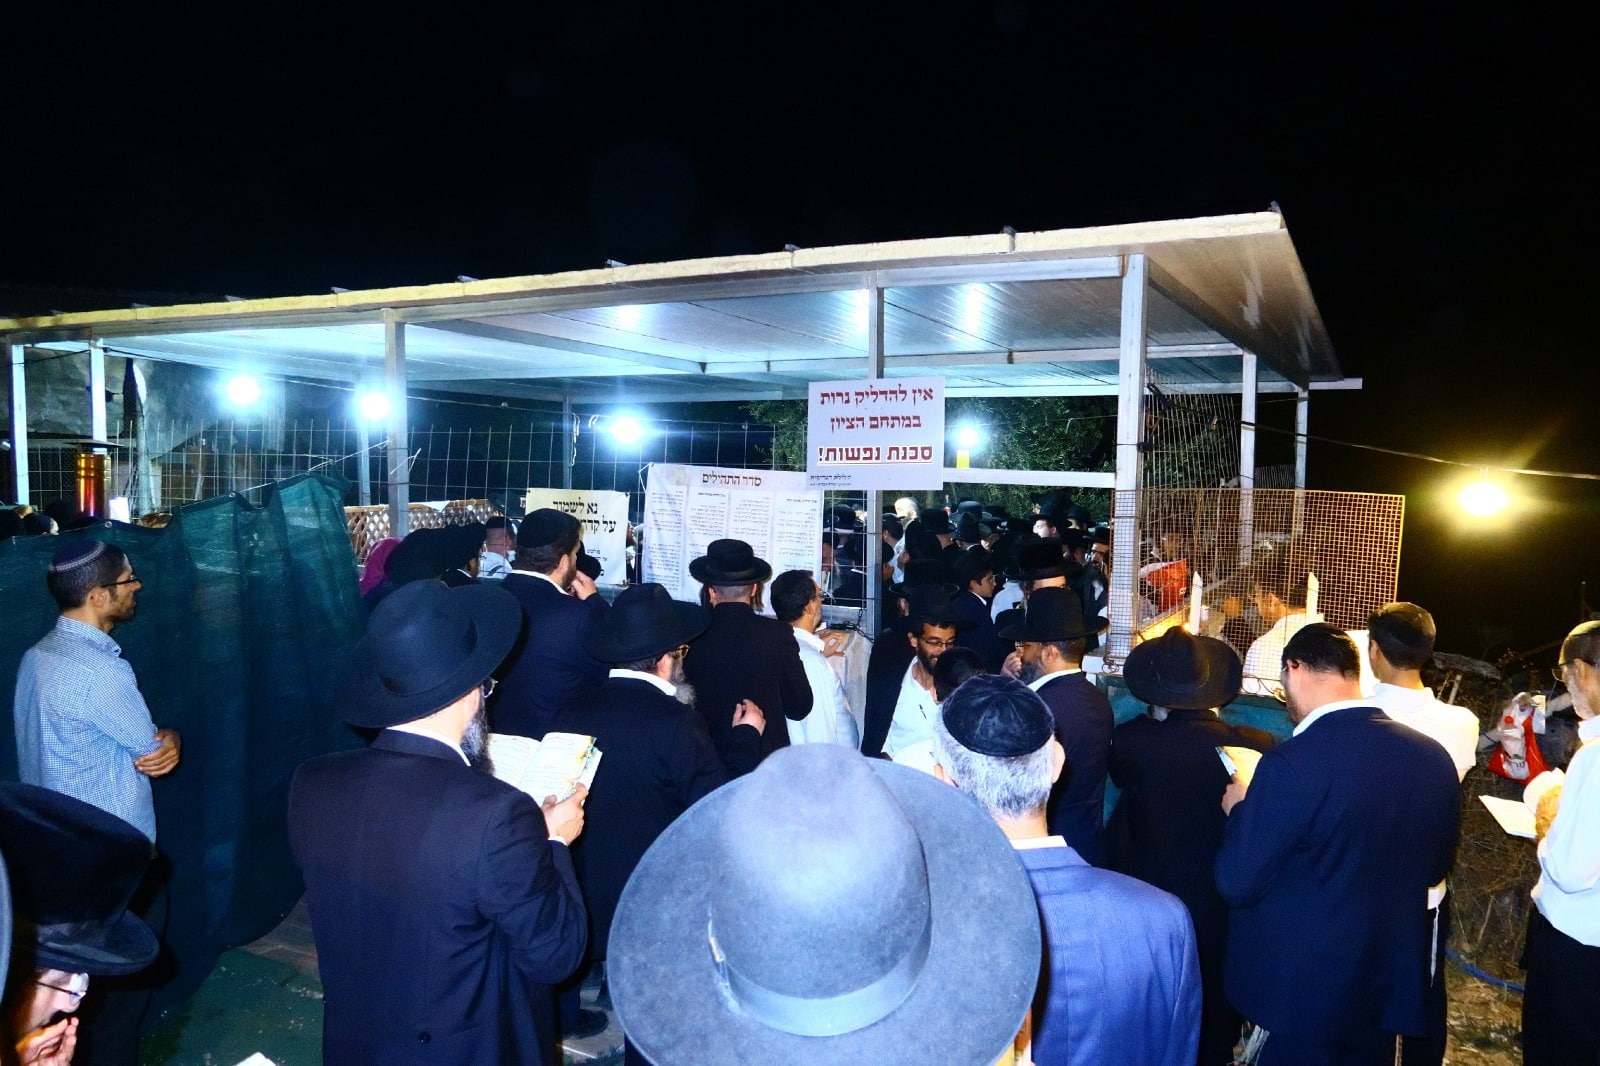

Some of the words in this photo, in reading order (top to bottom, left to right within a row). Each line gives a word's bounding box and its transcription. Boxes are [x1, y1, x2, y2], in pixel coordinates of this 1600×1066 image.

[820, 391, 851, 406] נרות
[855, 383, 908, 407] להדליק
[912, 388, 934, 407] אין
[830, 416, 865, 434] הציון
[869, 415, 922, 429] במתחם
[818, 447, 881, 462] נפשות!
[887, 446, 933, 461] סכנת
[702, 470, 740, 486] התהילים
[742, 476, 762, 487] סדר
[552, 496, 585, 513] לשמור
[586, 502, 598, 515] נא
[602, 515, 617, 534] על
